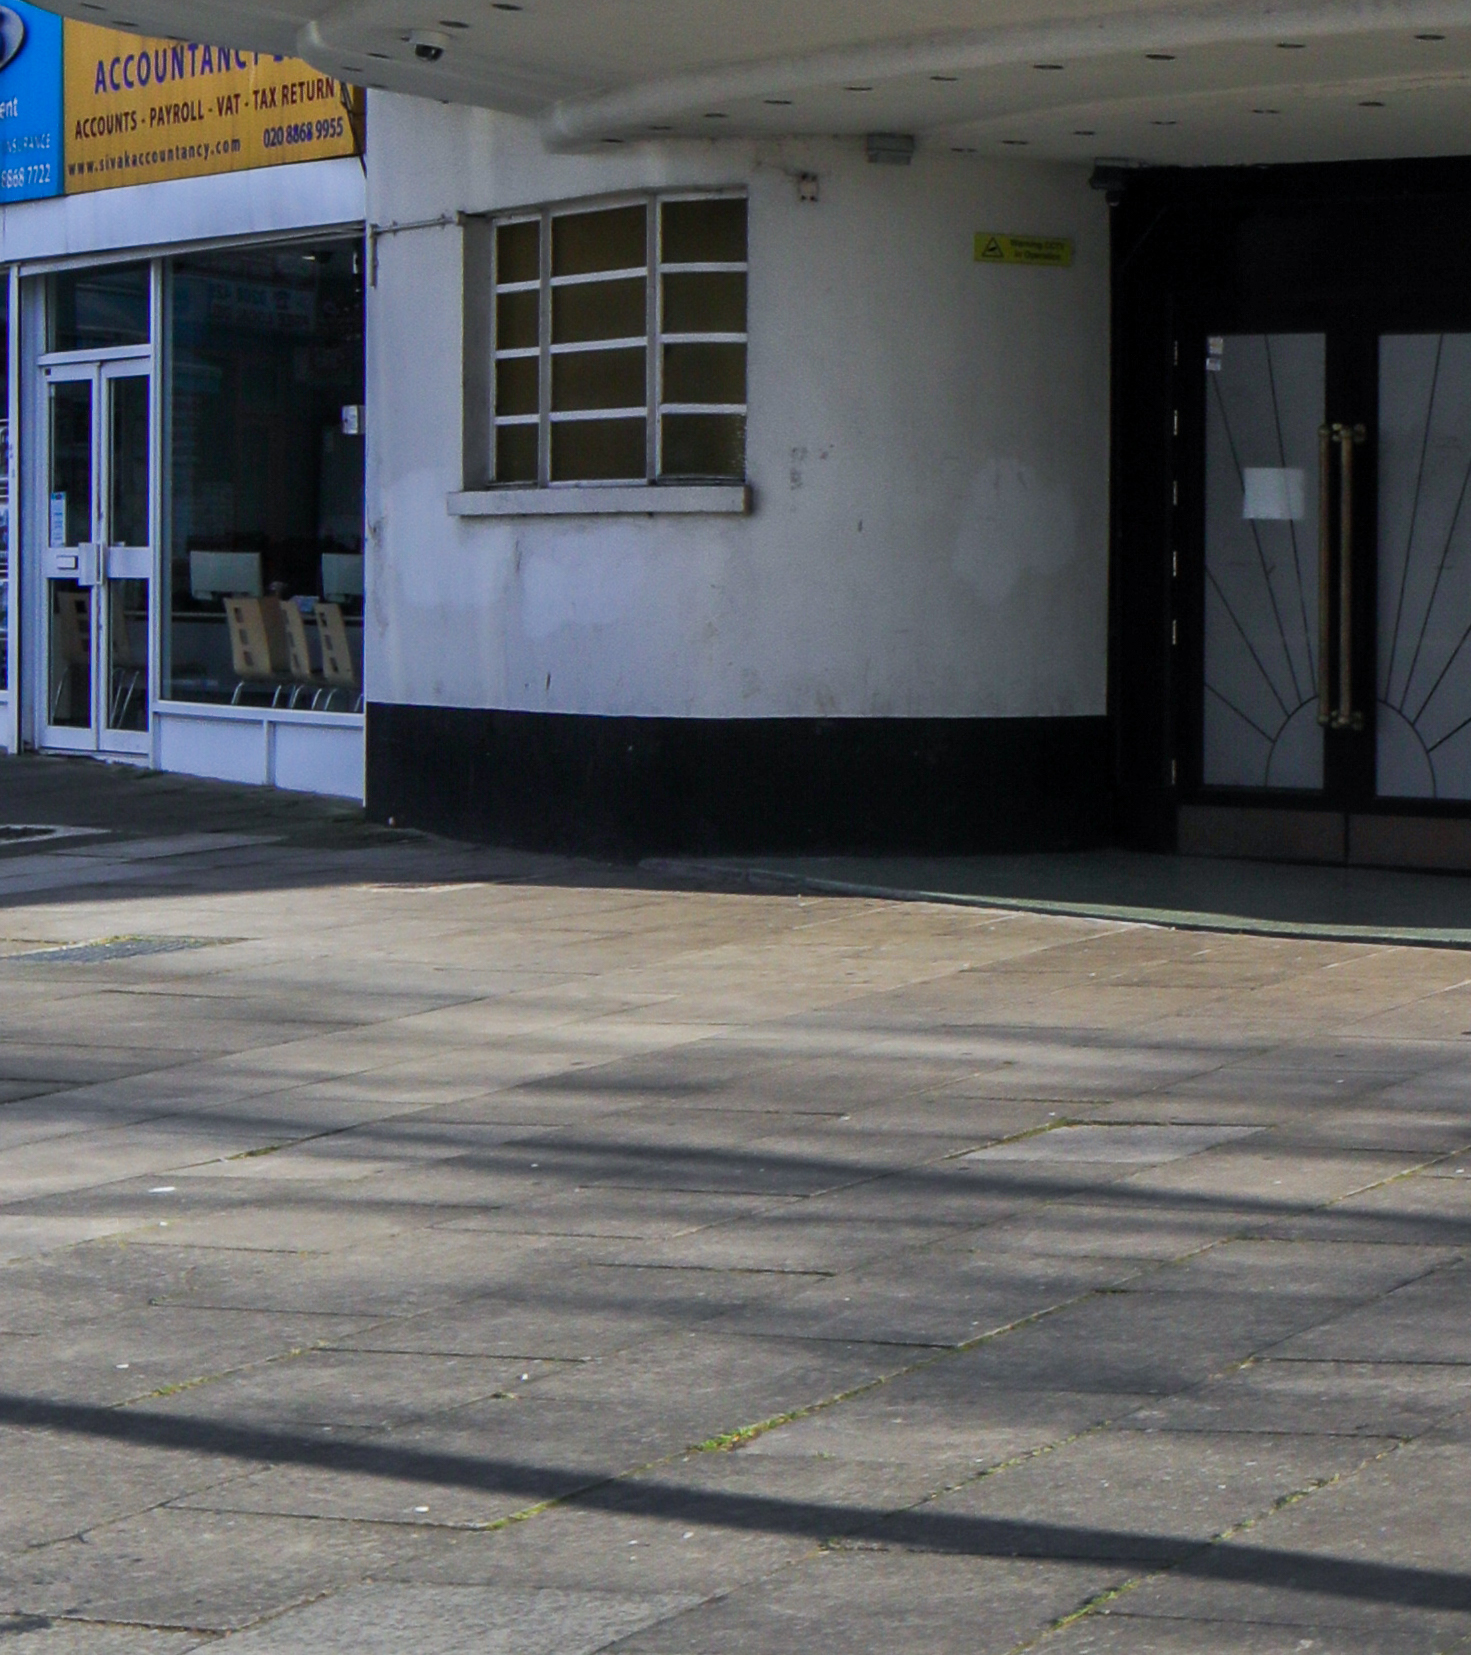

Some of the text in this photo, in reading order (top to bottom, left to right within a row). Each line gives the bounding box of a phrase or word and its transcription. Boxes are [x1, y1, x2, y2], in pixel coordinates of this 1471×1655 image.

[75, 110, 137, 140] ACCOUNTS
[150, 99, 204, 128] PAYROLL
[217, 93, 241, 117] VAT
[252, 88, 277, 111] TAX
[263, 116, 344, 148] 020 8868 9955
[27, 163, 50, 184] 7722
[68, 137, 241, 177] www.sivakaccountancy.com
